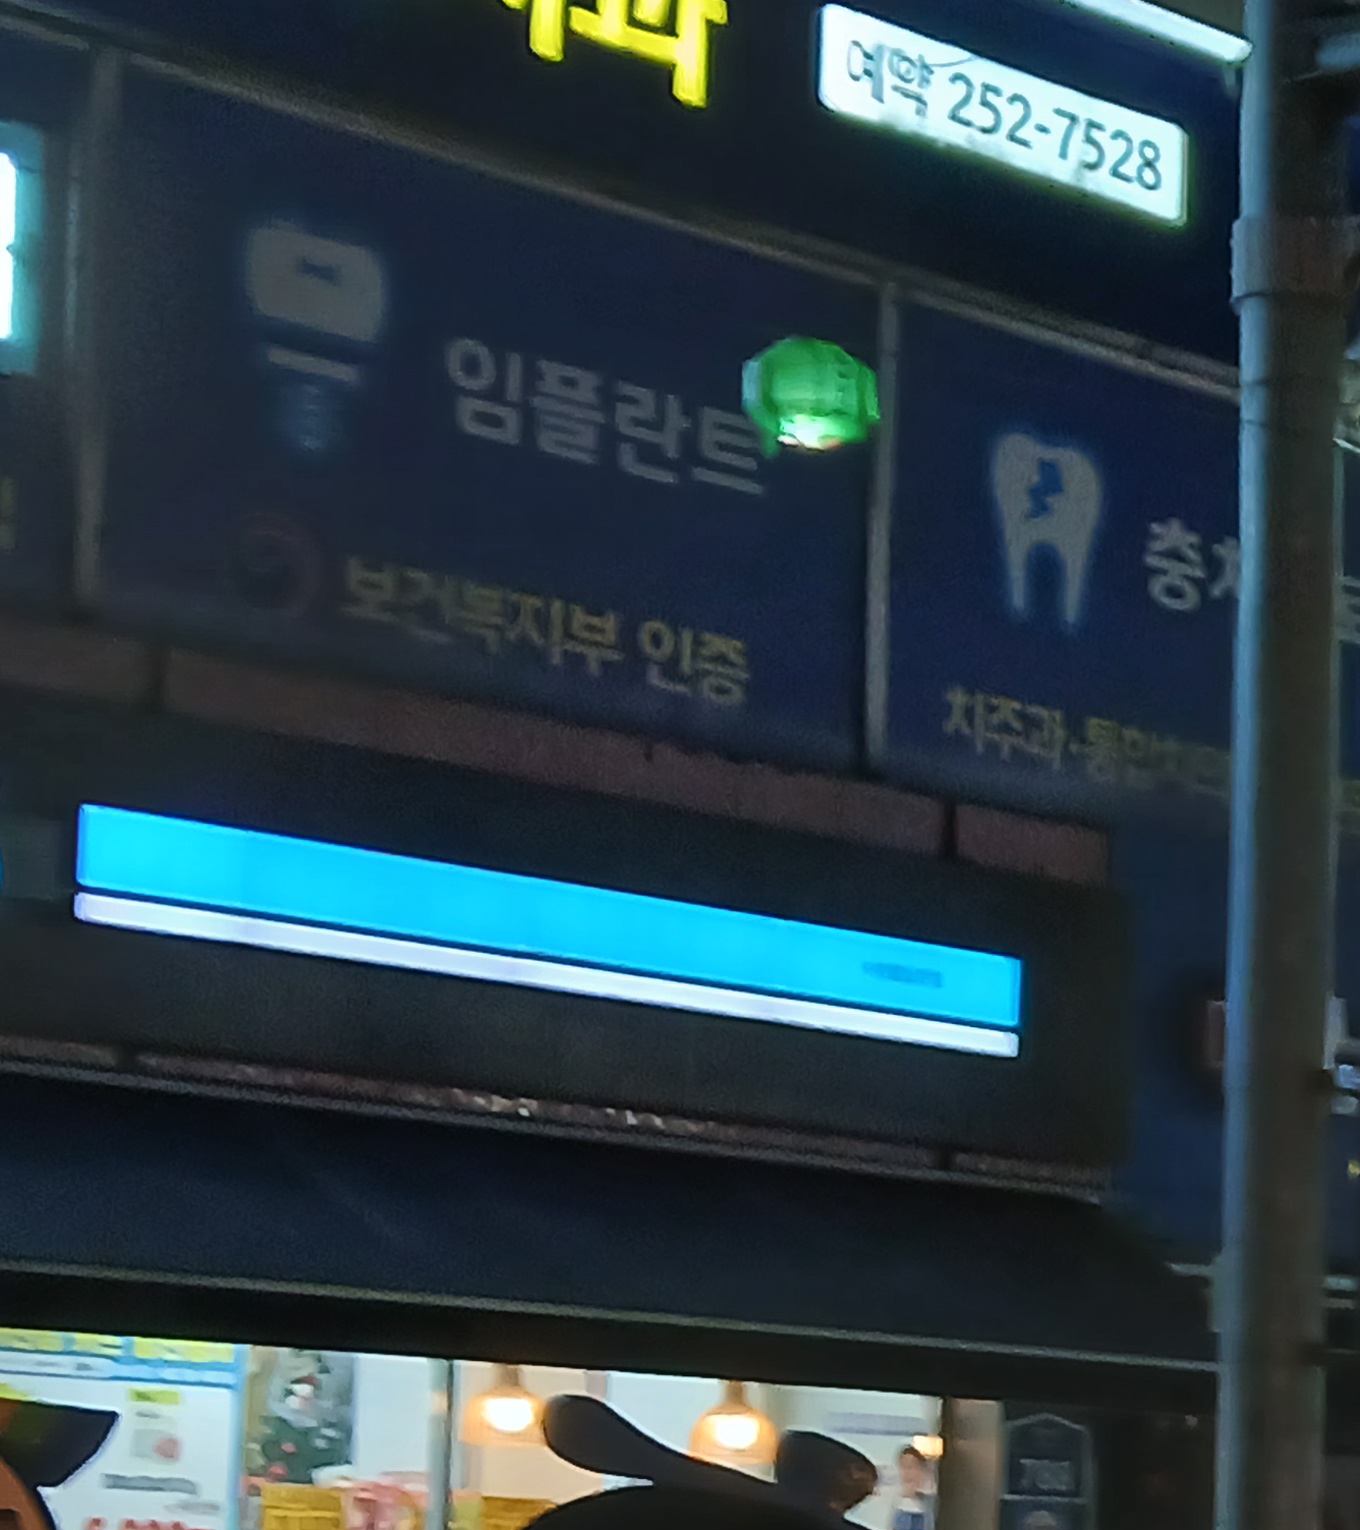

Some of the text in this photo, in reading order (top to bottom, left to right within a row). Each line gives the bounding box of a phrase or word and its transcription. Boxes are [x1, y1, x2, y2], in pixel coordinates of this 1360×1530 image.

[845, 40, 1164, 192] 예약 252-7528
[445, 336, 768, 496] 임플란트
[636, 618, 752, 710] 인증
